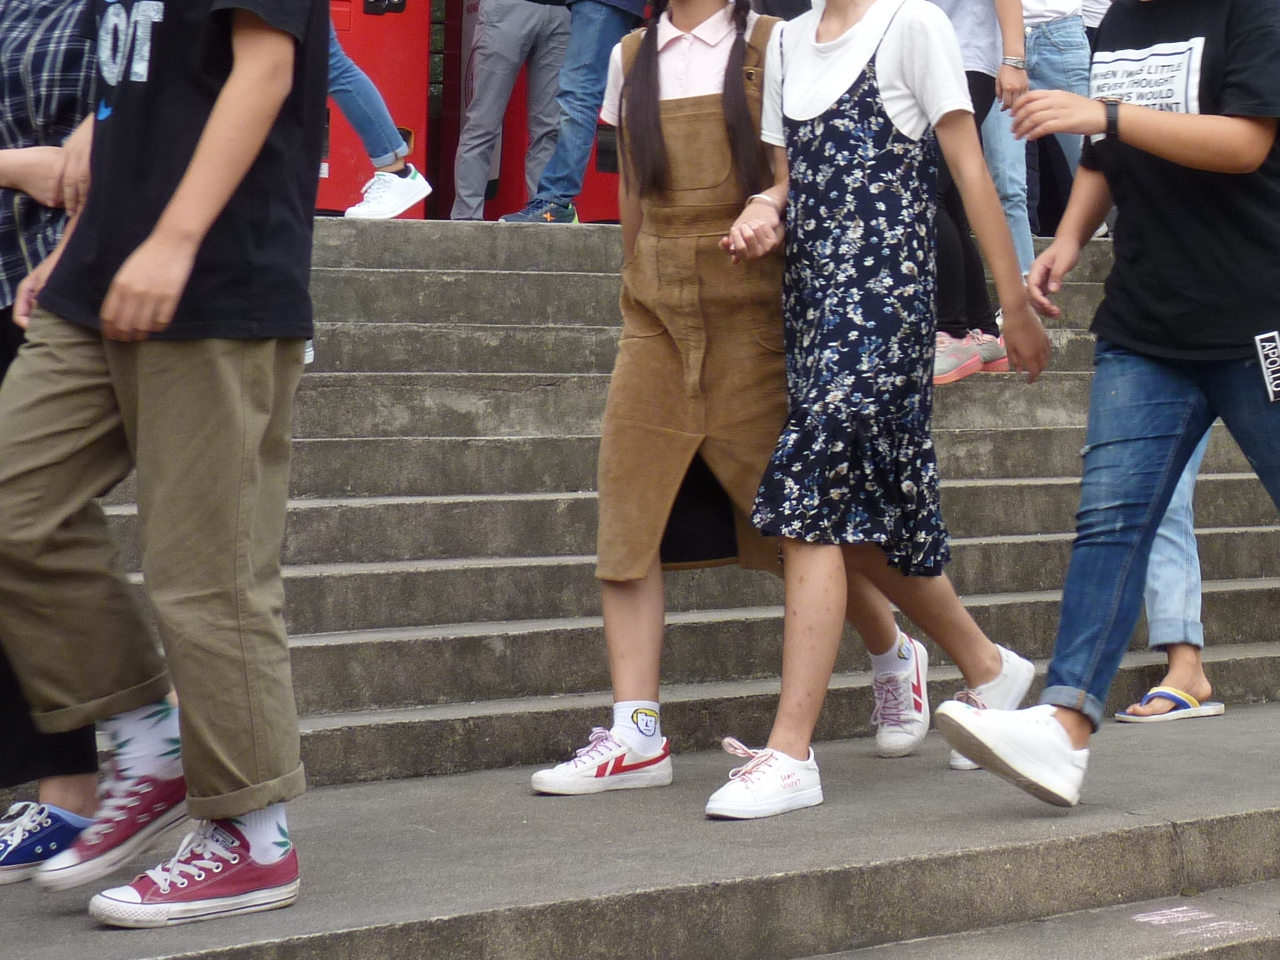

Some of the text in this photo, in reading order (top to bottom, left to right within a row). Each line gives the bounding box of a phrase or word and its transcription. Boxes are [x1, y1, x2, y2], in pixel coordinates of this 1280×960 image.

[1147, 62, 1183, 75] LITTLE
[1095, 75, 1177, 93] NEVER THOUGHT
[1136, 88, 1175, 101] WOULD
